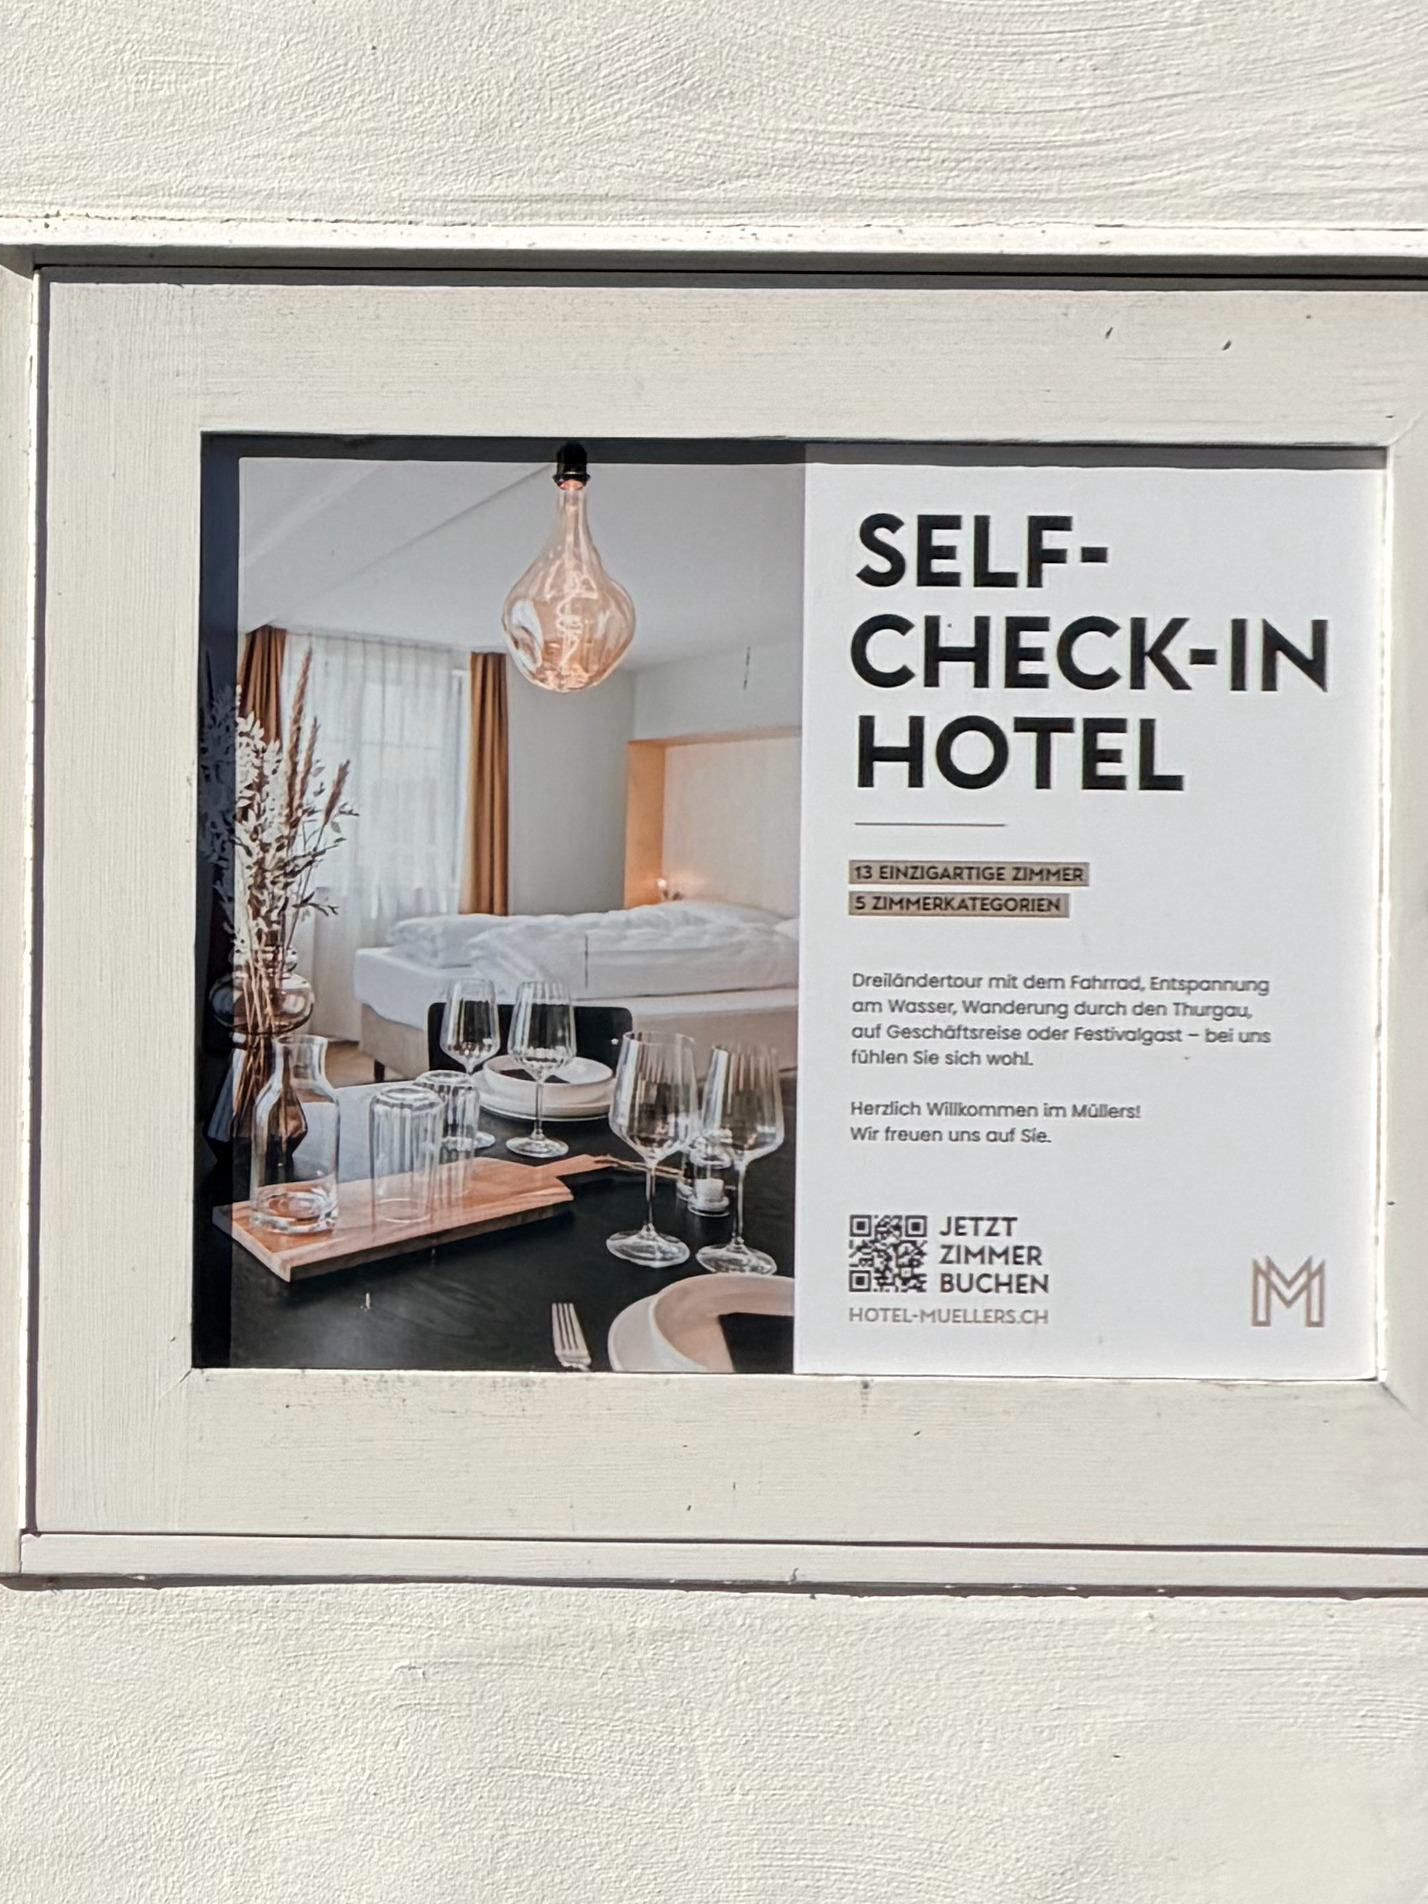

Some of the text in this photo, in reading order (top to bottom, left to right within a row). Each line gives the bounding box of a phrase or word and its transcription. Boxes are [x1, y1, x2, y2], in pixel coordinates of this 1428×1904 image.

[855, 512, 1109, 589] SELF-
[850, 613, 1328, 693] CHECK-IN
[857, 714, 1184, 791] HOTEL
[854, 864, 1084, 882] 13 EINZIGARTIGE ZIMMER
[854, 895, 1061, 913] 5 ZIMMERKATEGORIEN
[852, 972, 1270, 996] Dreiländertour mit dem Fahrrad, Entspannung
[851, 999, 1253, 1021] am Wasser, Wanderung durch den Thurgau,
[851, 1023, 882, 1039] auf
[885, 1024, 1022, 1041] Geschäftsreise
[1026, 1026, 1070, 1041] oder
[1074, 1026, 1183, 1046] Festivalgast
[1204, 1027, 1234, 1044] bei
[1238, 1031, 1272, 1044] uns
[851, 1048, 1034, 1067] fühlen Sie sich wohl.
[850, 1100, 1141, 1119] Herzlich Willkommen im Müllers!
[850, 1125, 1052, 1144] Wir freuen uns auf Sie.
[939, 1215, 1019, 1237] JETZT
[938, 1244, 1043, 1266] ZIMMER
[940, 1272, 1049, 1294] BUCHEN
[848, 1307, 1049, 1325] HOTEL-MUELLERS.CH
